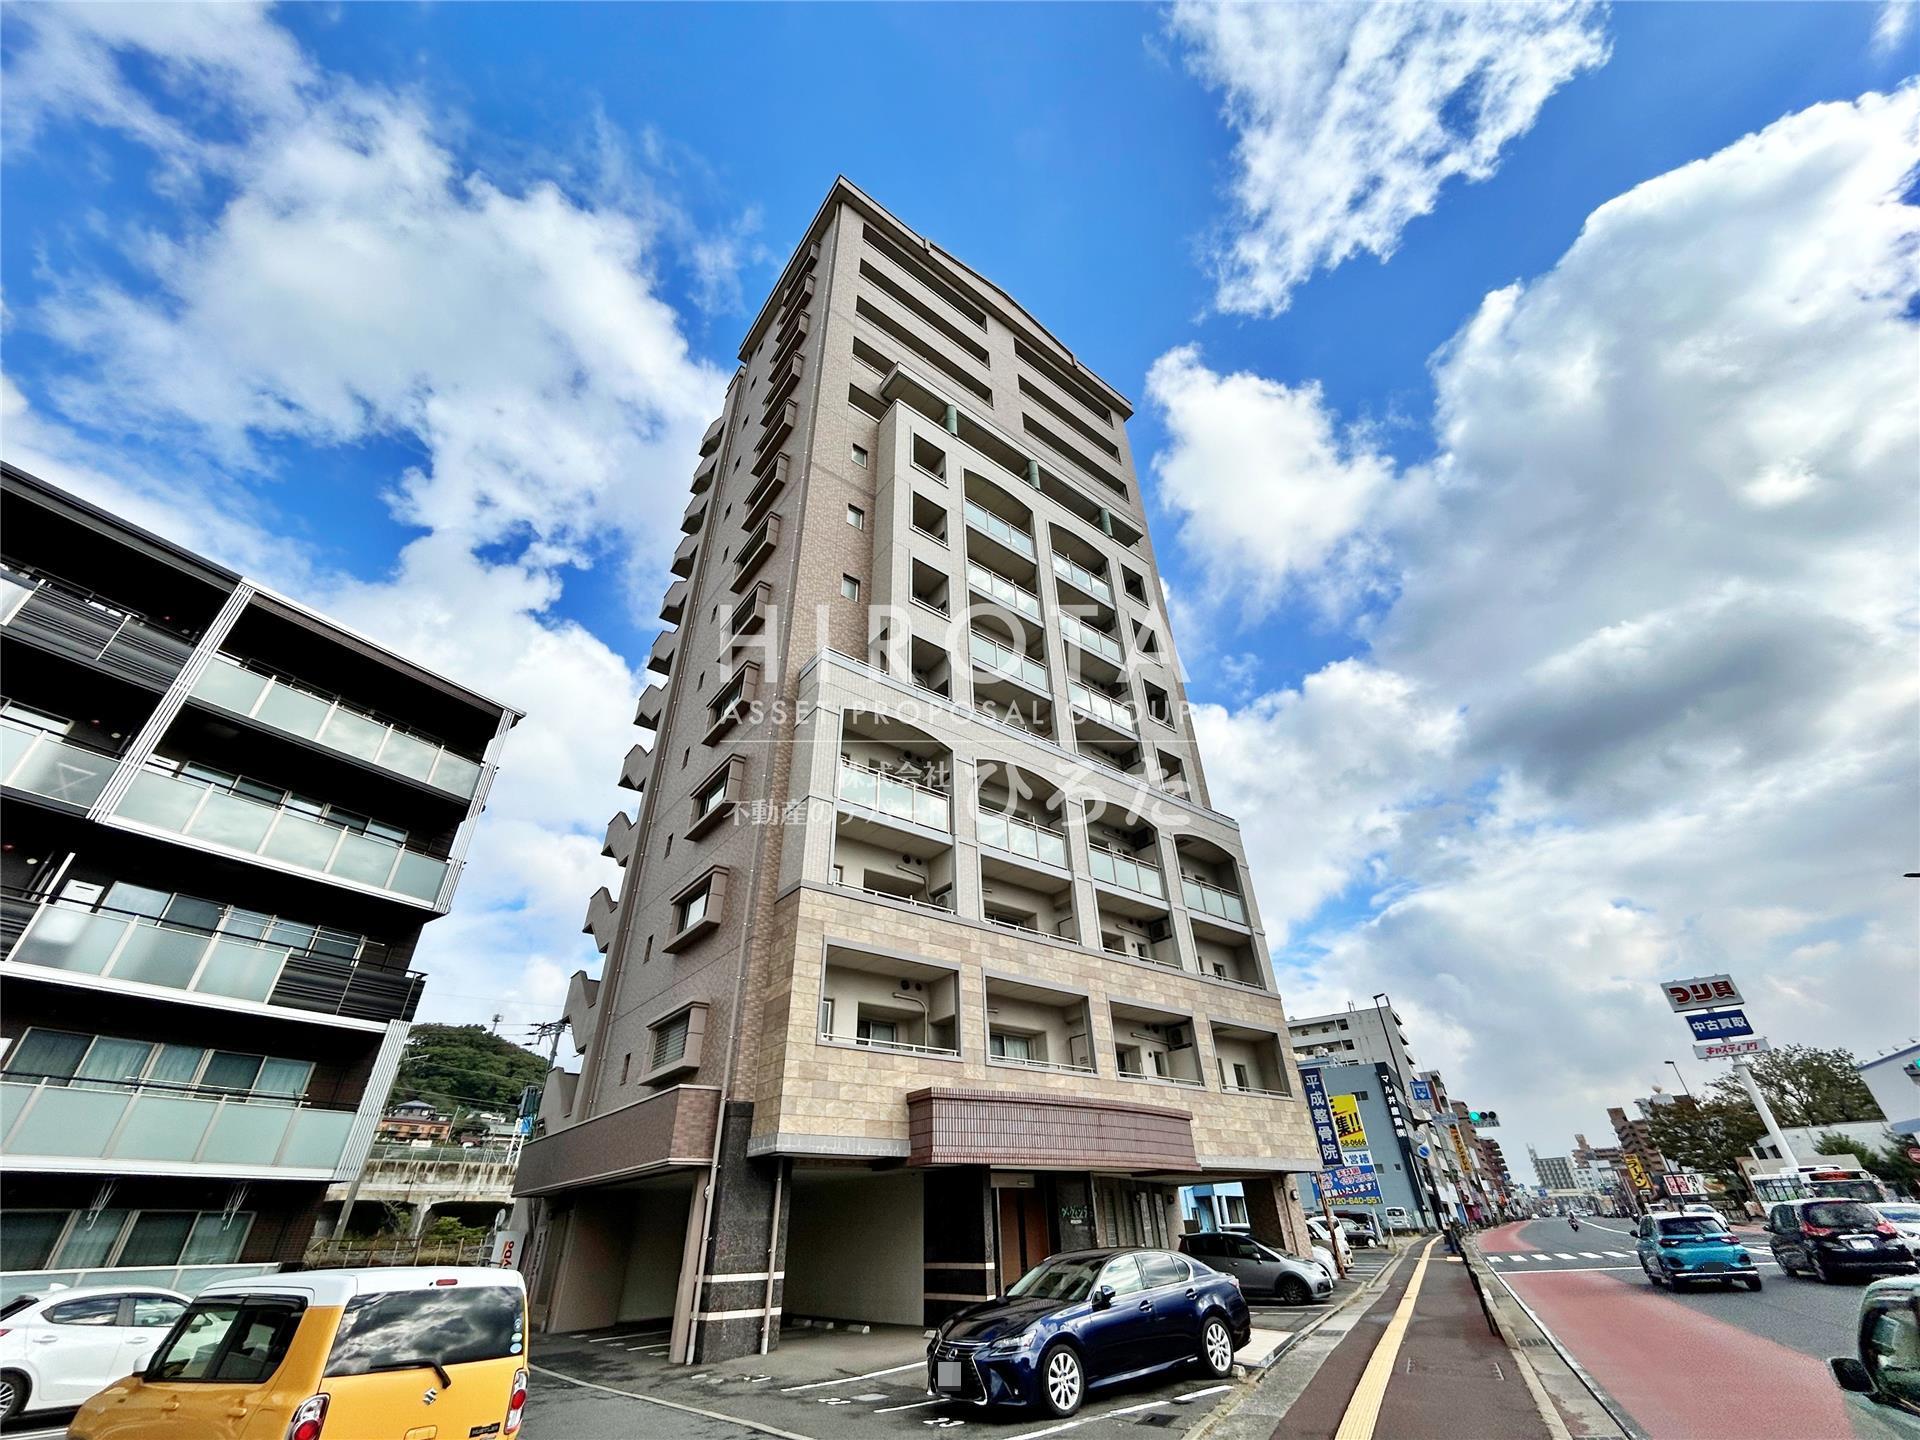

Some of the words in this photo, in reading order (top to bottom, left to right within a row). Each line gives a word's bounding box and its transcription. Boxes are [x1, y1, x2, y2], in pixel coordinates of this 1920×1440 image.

[1692, 1017, 1747, 1033] 中古買取
[1305, 1075, 1338, 1160] 平成整骨院
[503, 1240, 515, 1269] yDo
